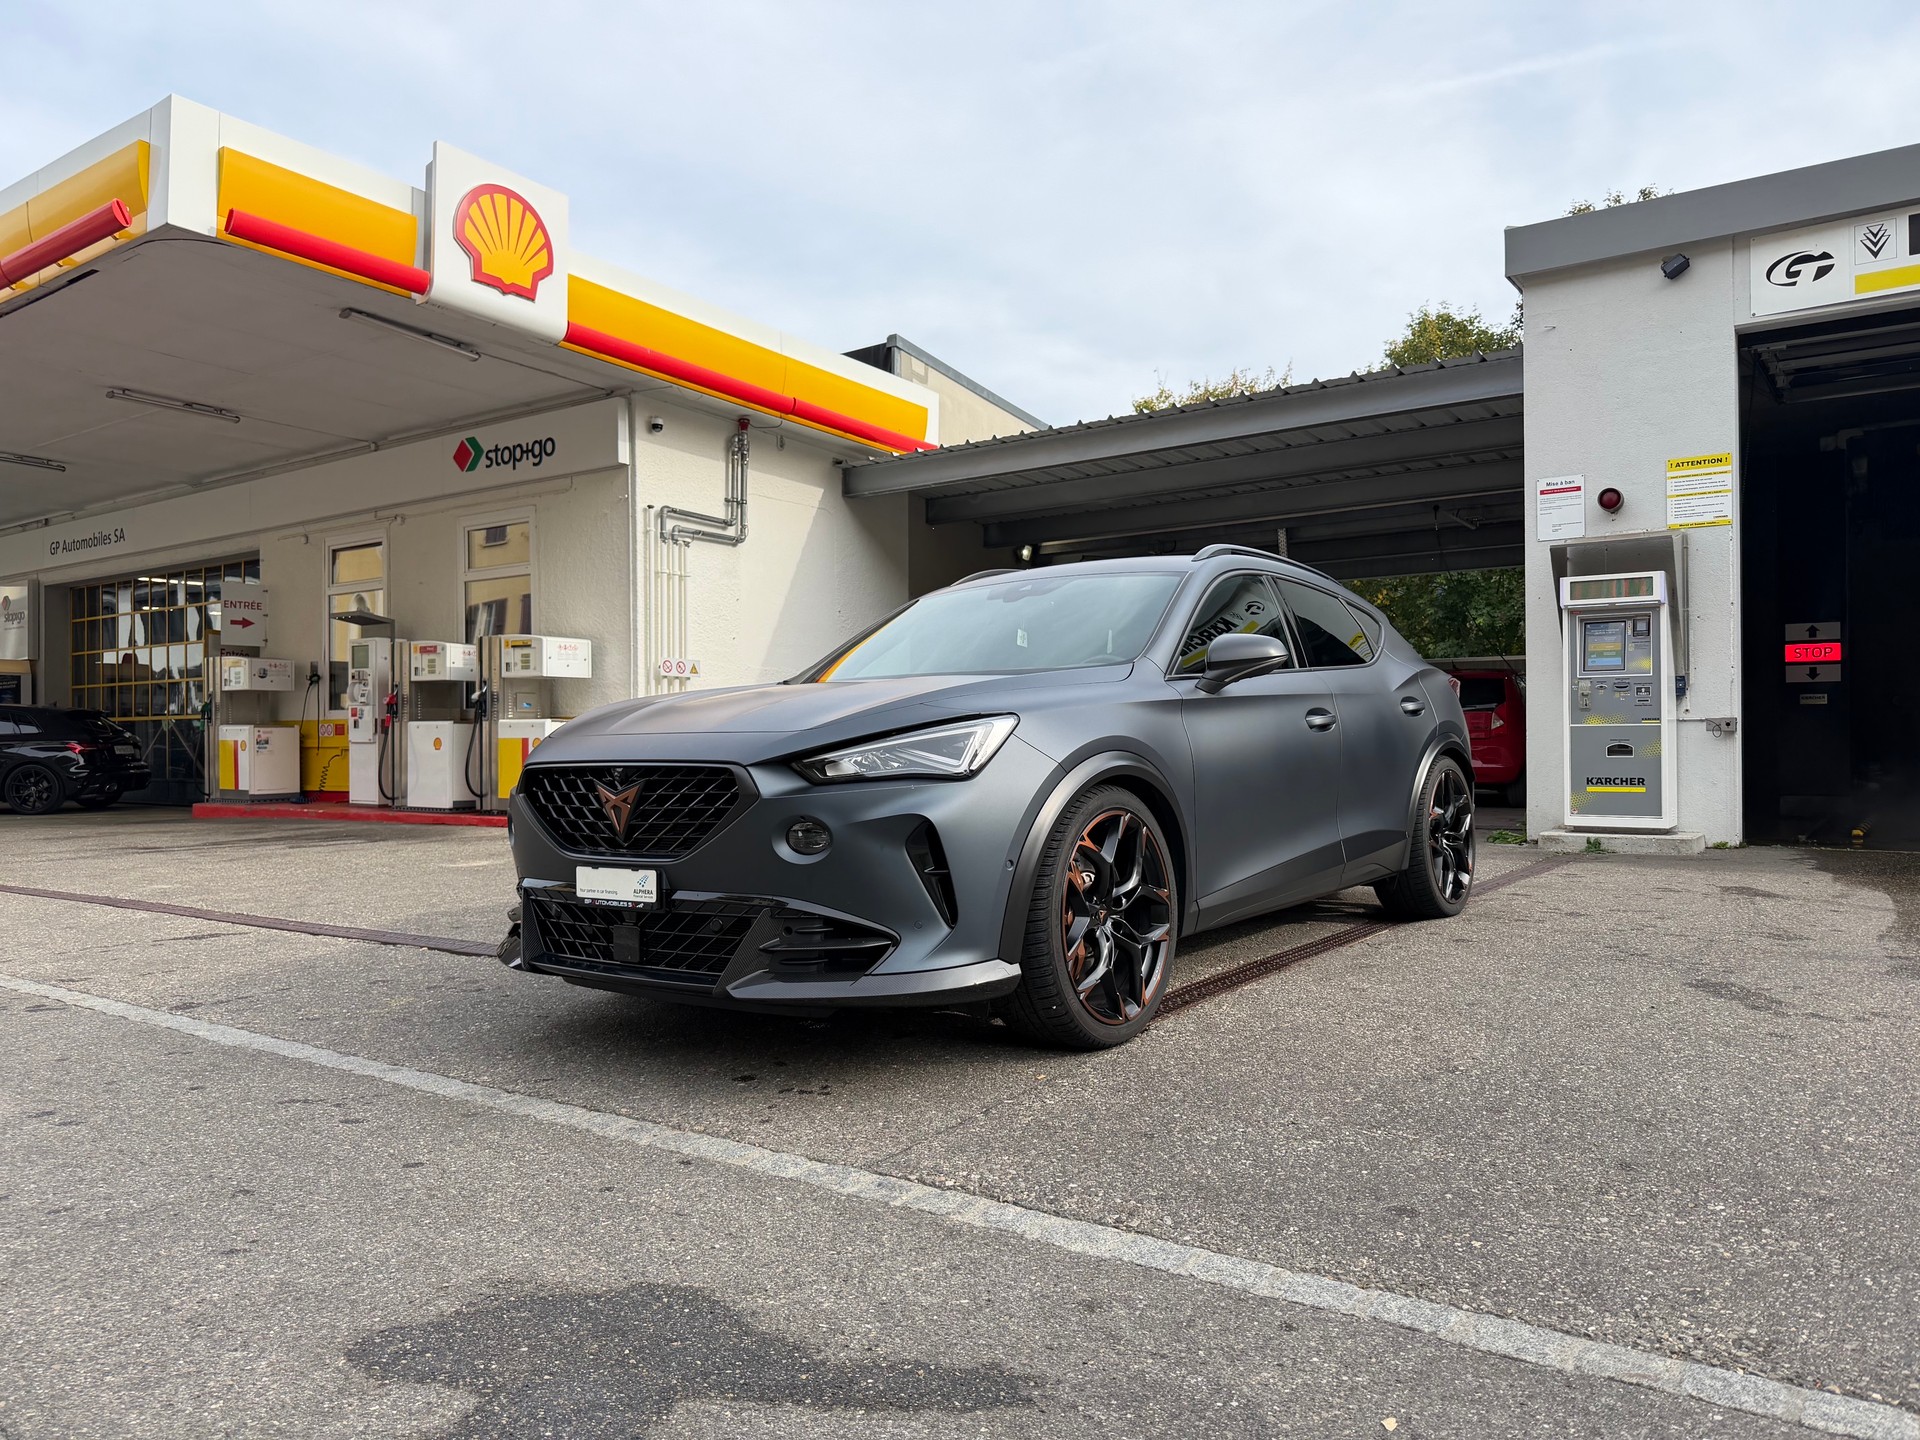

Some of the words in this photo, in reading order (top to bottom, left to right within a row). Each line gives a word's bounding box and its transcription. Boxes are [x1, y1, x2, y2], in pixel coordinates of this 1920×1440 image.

[485, 437, 556, 471] stop+go
[1675, 457, 1723, 468] ATTENTION
[49, 541, 60, 555] GP
[62, 530, 112, 553] Automobiles
[114, 527, 126, 543] SA
[223, 600, 263, 611] ENTRÉE
[1794, 646, 1833, 659] STOP
[1586, 776, 1646, 786] KÄRCHER
